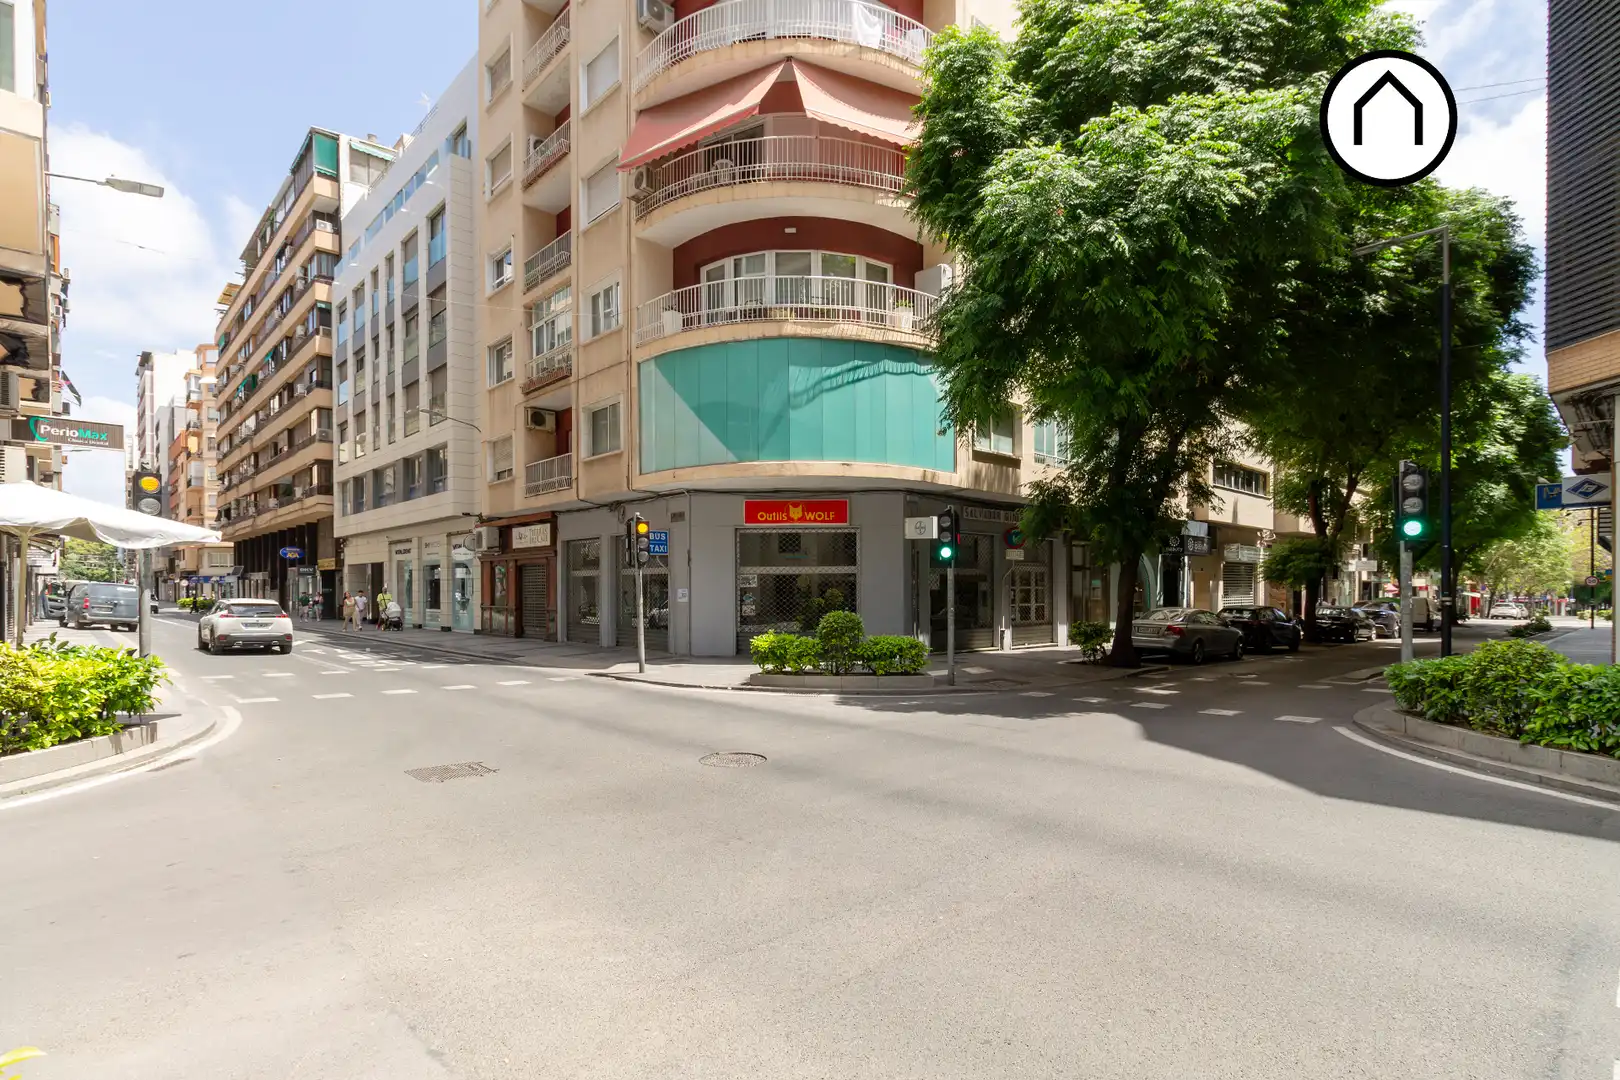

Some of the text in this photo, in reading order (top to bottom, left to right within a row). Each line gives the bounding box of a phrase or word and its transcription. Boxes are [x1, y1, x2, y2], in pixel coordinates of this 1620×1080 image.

[40, 424, 108, 441] PerioMax
[757, 511, 835, 521] Outils WOLF
[649, 532, 666, 540] BUS
[649, 544, 667, 553] TAXI
